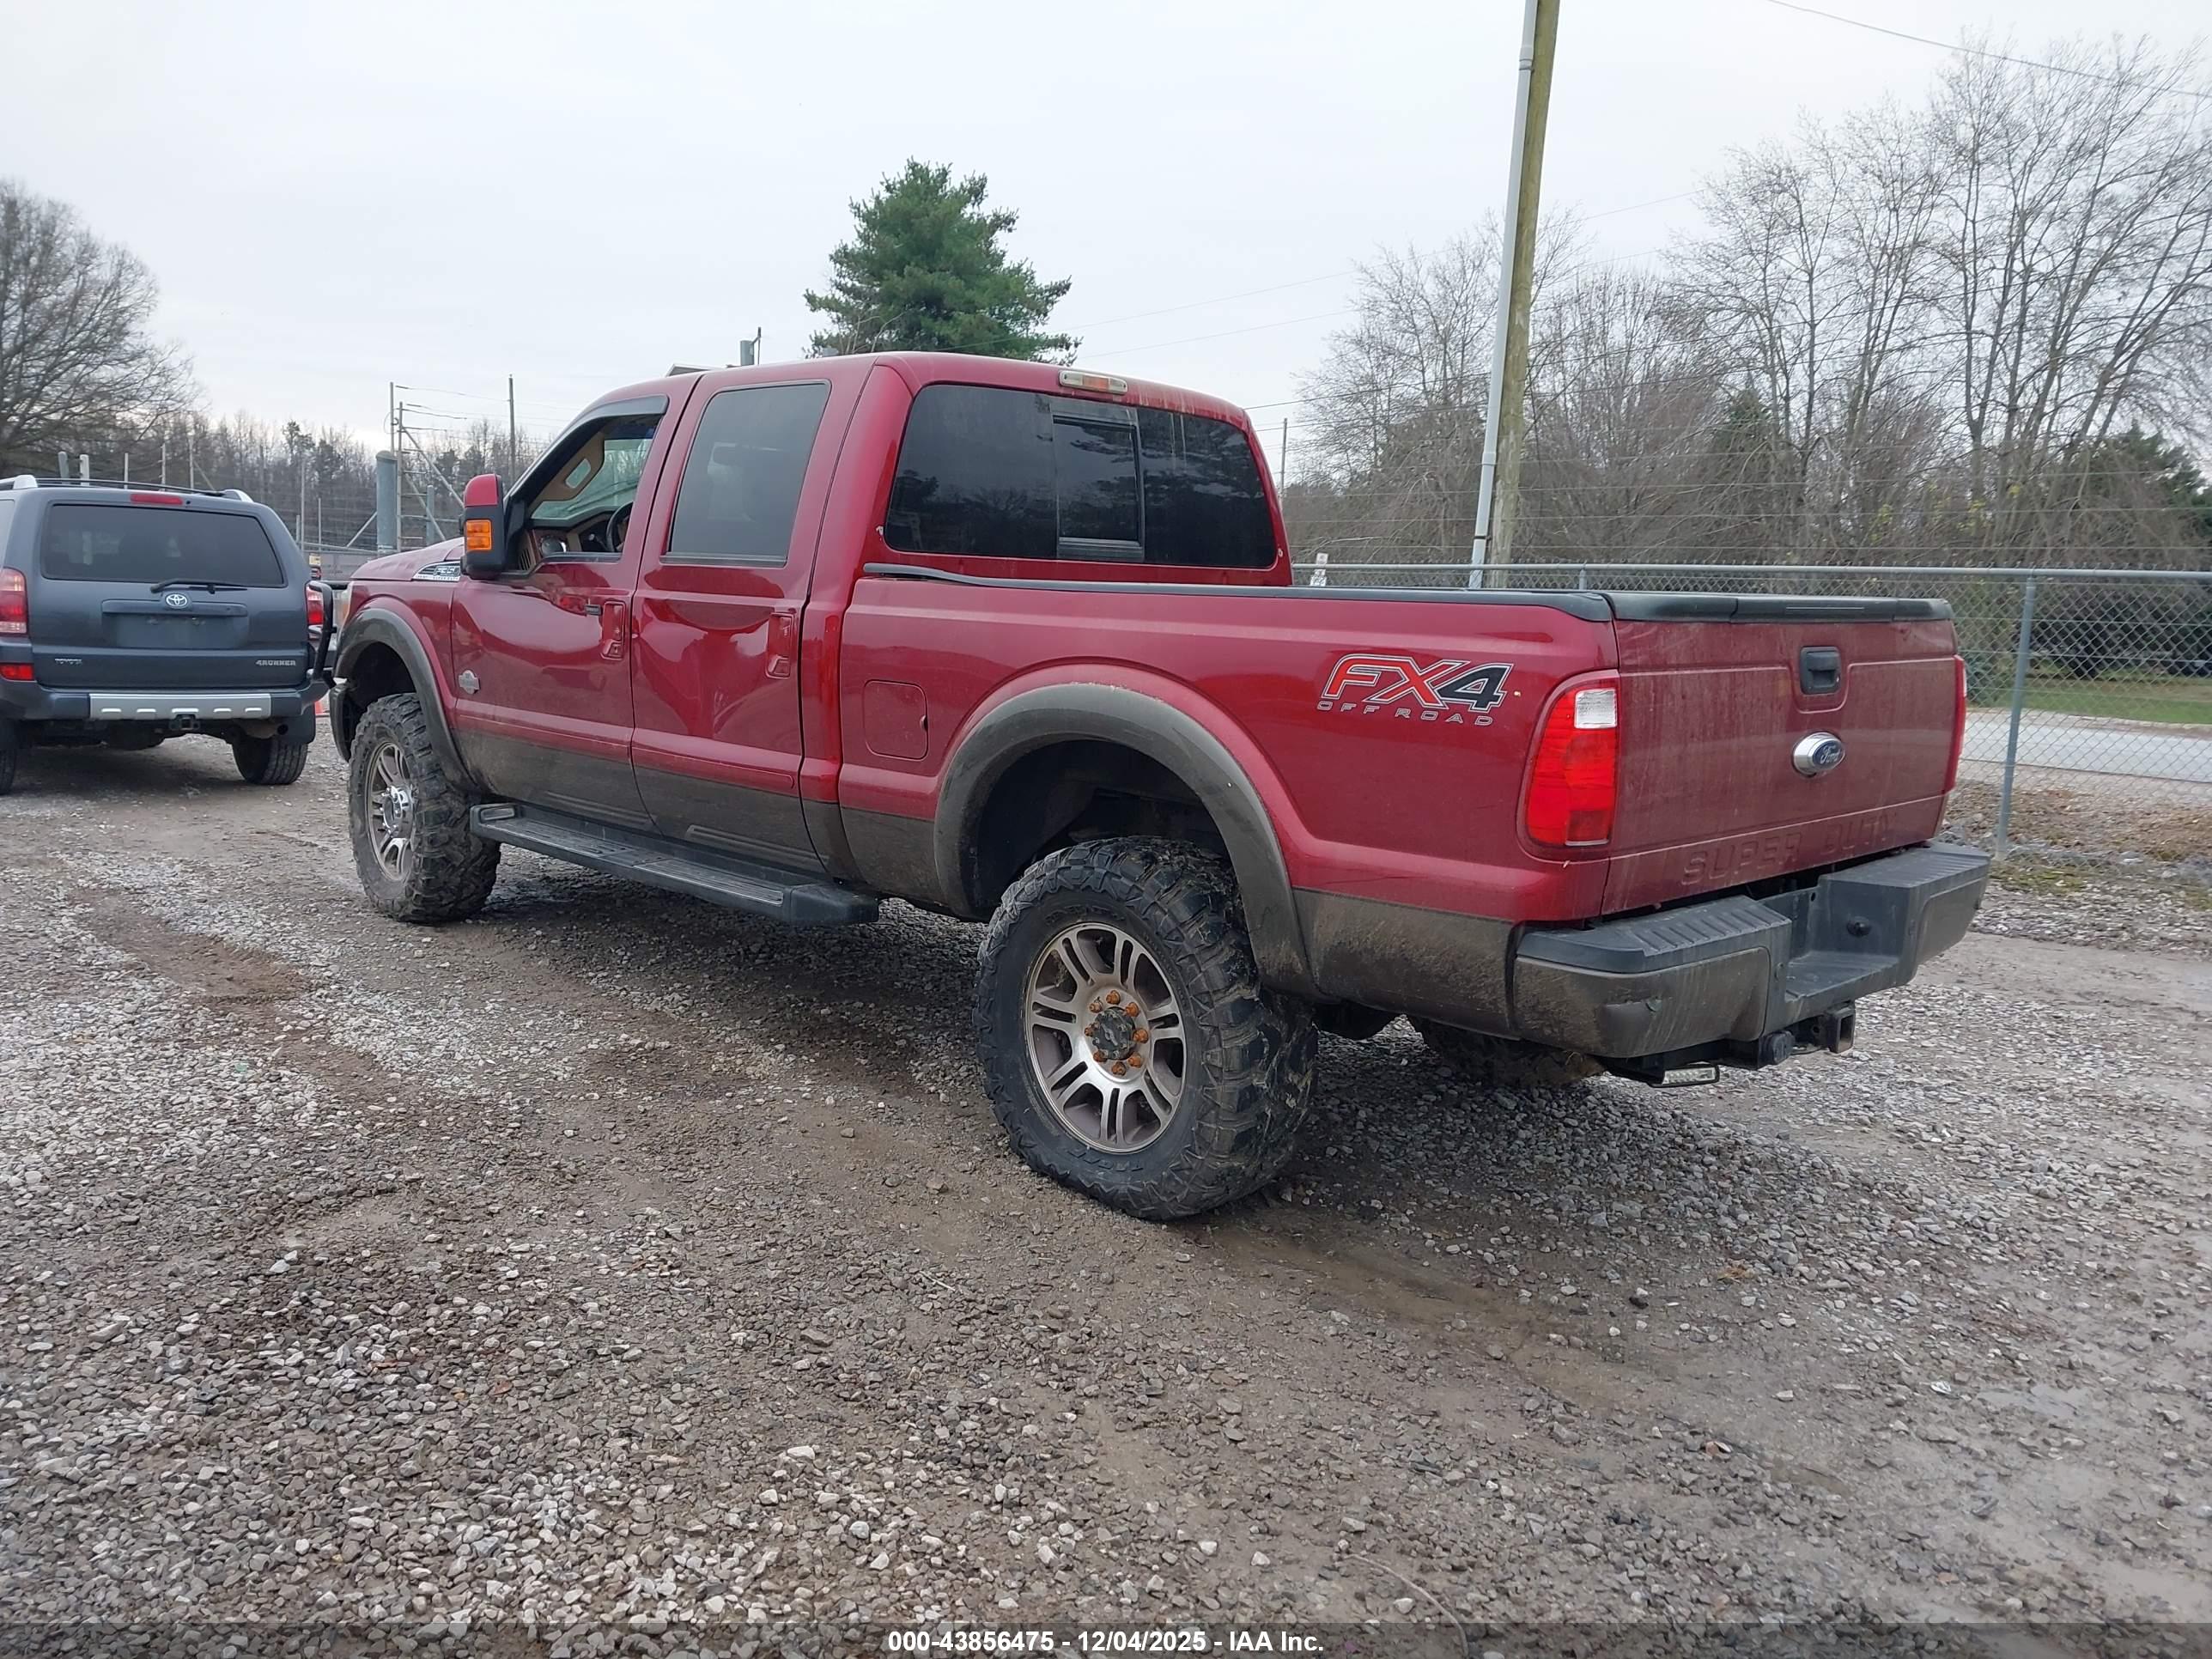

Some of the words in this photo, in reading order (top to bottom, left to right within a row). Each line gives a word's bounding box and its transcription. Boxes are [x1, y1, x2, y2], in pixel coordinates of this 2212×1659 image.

[1320, 653, 1514, 714] FX4
[1316, 701, 1381, 715] OFF
[1395, 708, 1494, 726] ROAD
[1820, 744, 1842, 764] Ford
[1680, 831, 1803, 886] SUPER
[1820, 810, 1897, 856] DUTY
